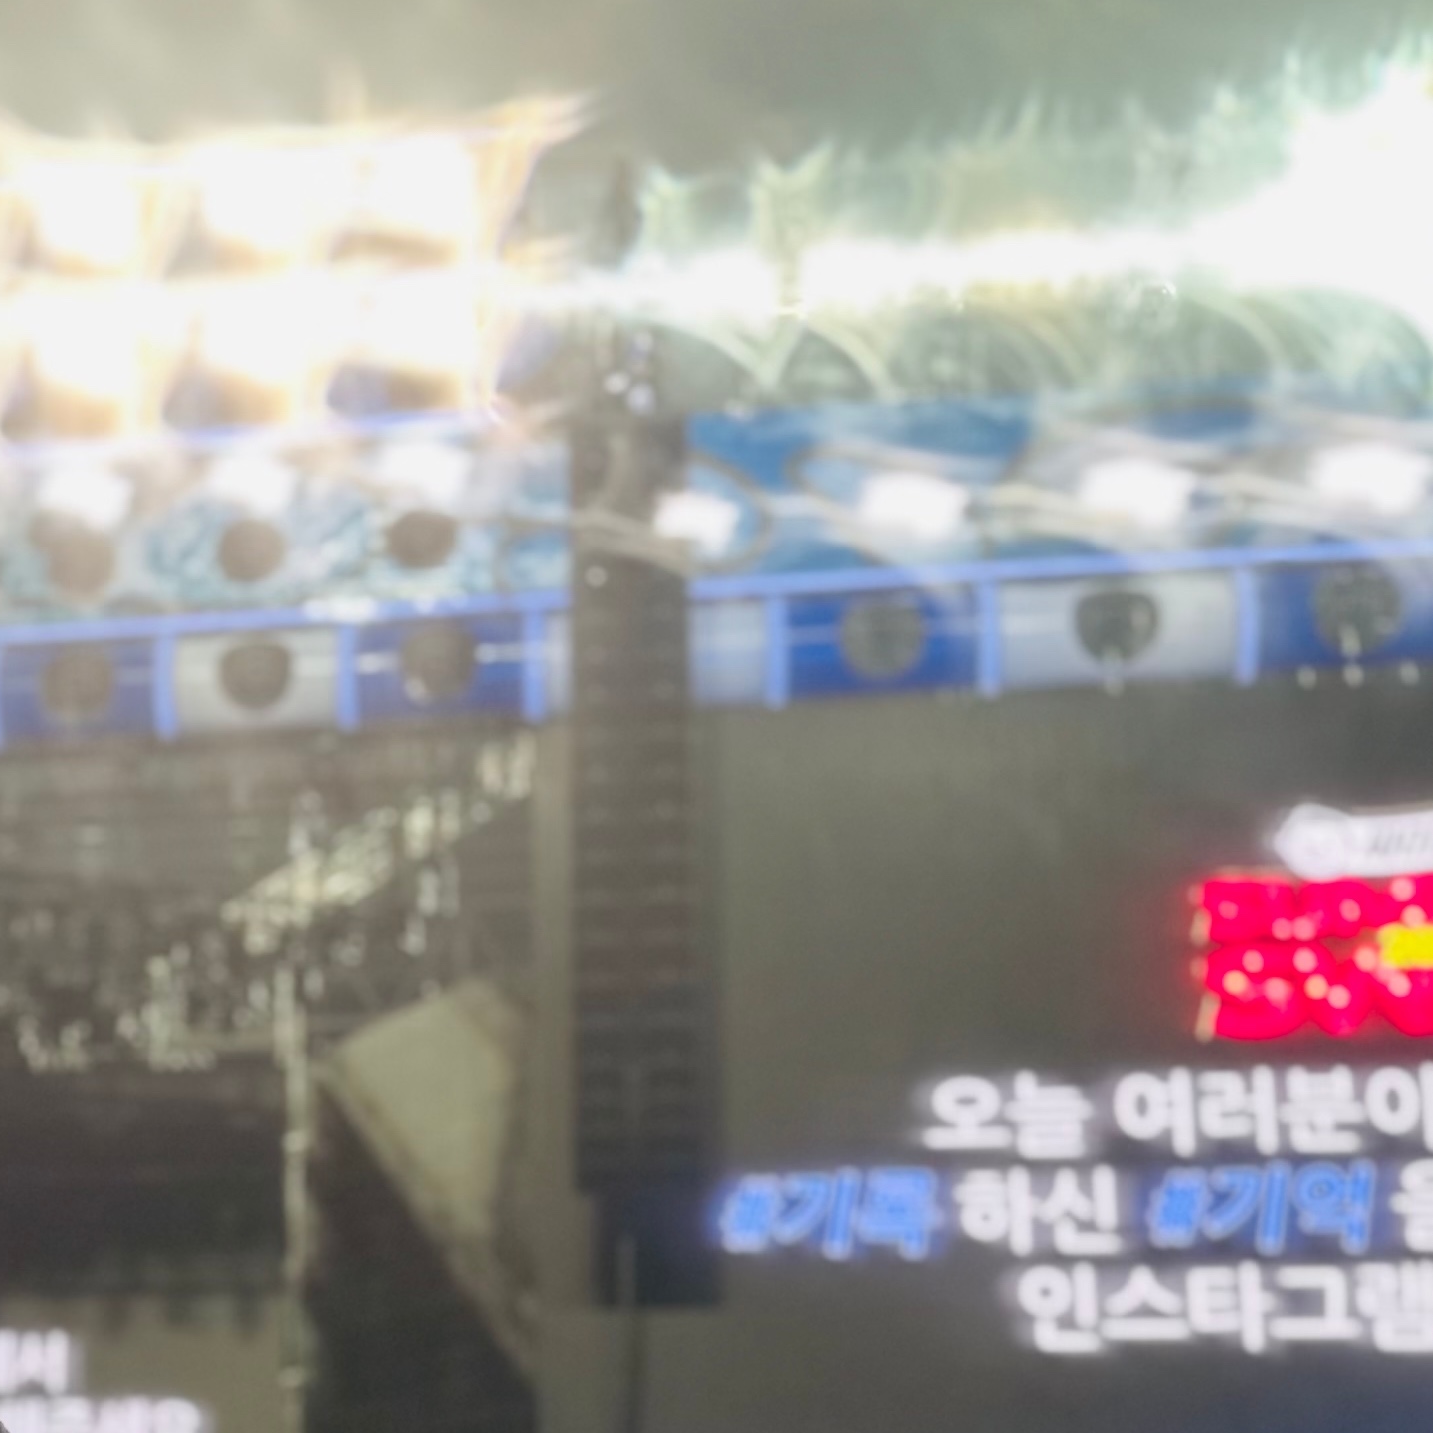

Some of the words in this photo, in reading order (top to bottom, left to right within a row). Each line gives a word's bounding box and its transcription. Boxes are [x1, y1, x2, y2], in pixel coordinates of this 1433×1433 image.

[922, 1070, 1094, 1160] 오늘
[1113, 1058, 1433, 1158] 여러분이
[953, 1162, 1123, 1258] 하신
[1146, 1159, 1376, 1257] #기억
